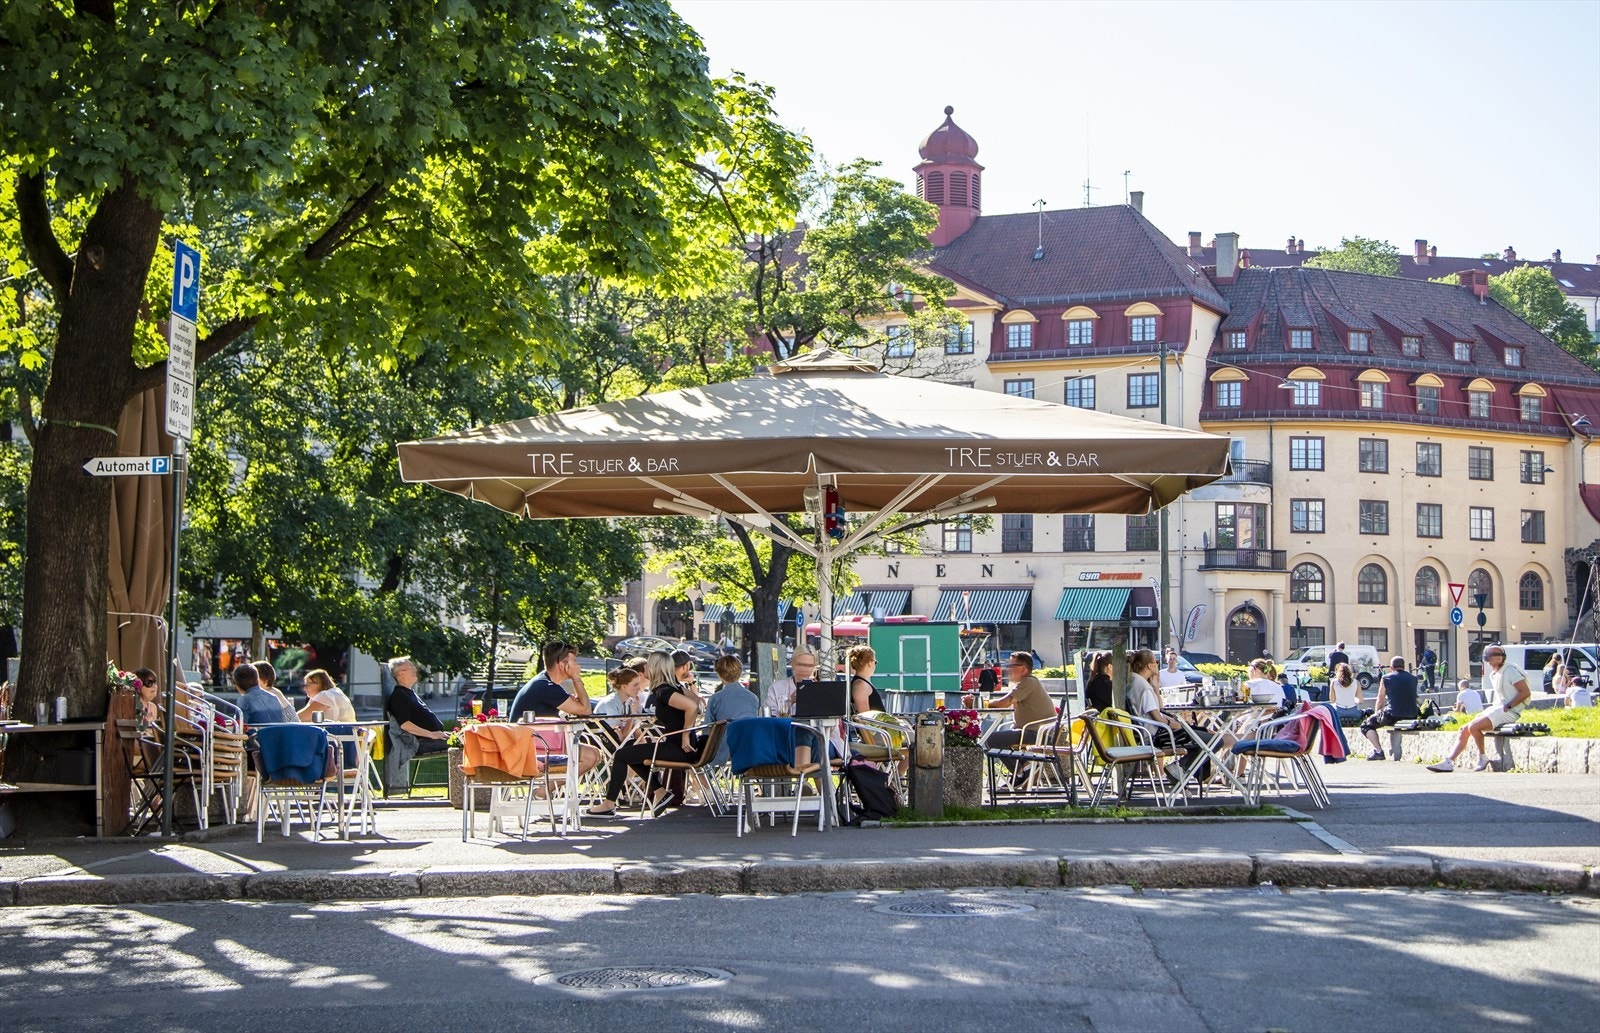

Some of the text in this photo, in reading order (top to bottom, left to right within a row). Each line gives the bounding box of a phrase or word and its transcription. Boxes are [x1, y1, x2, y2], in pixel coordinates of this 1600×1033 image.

[178, 253, 194, 306] P
[172, 382, 188, 399] 09-20
[170, 399, 190, 418] (09-20)
[96, 459, 165, 472] Automat P
[526, 453, 680, 475] TRE STUER & BAR
[944, 447, 1100, 468] TRE STUER & BAR
